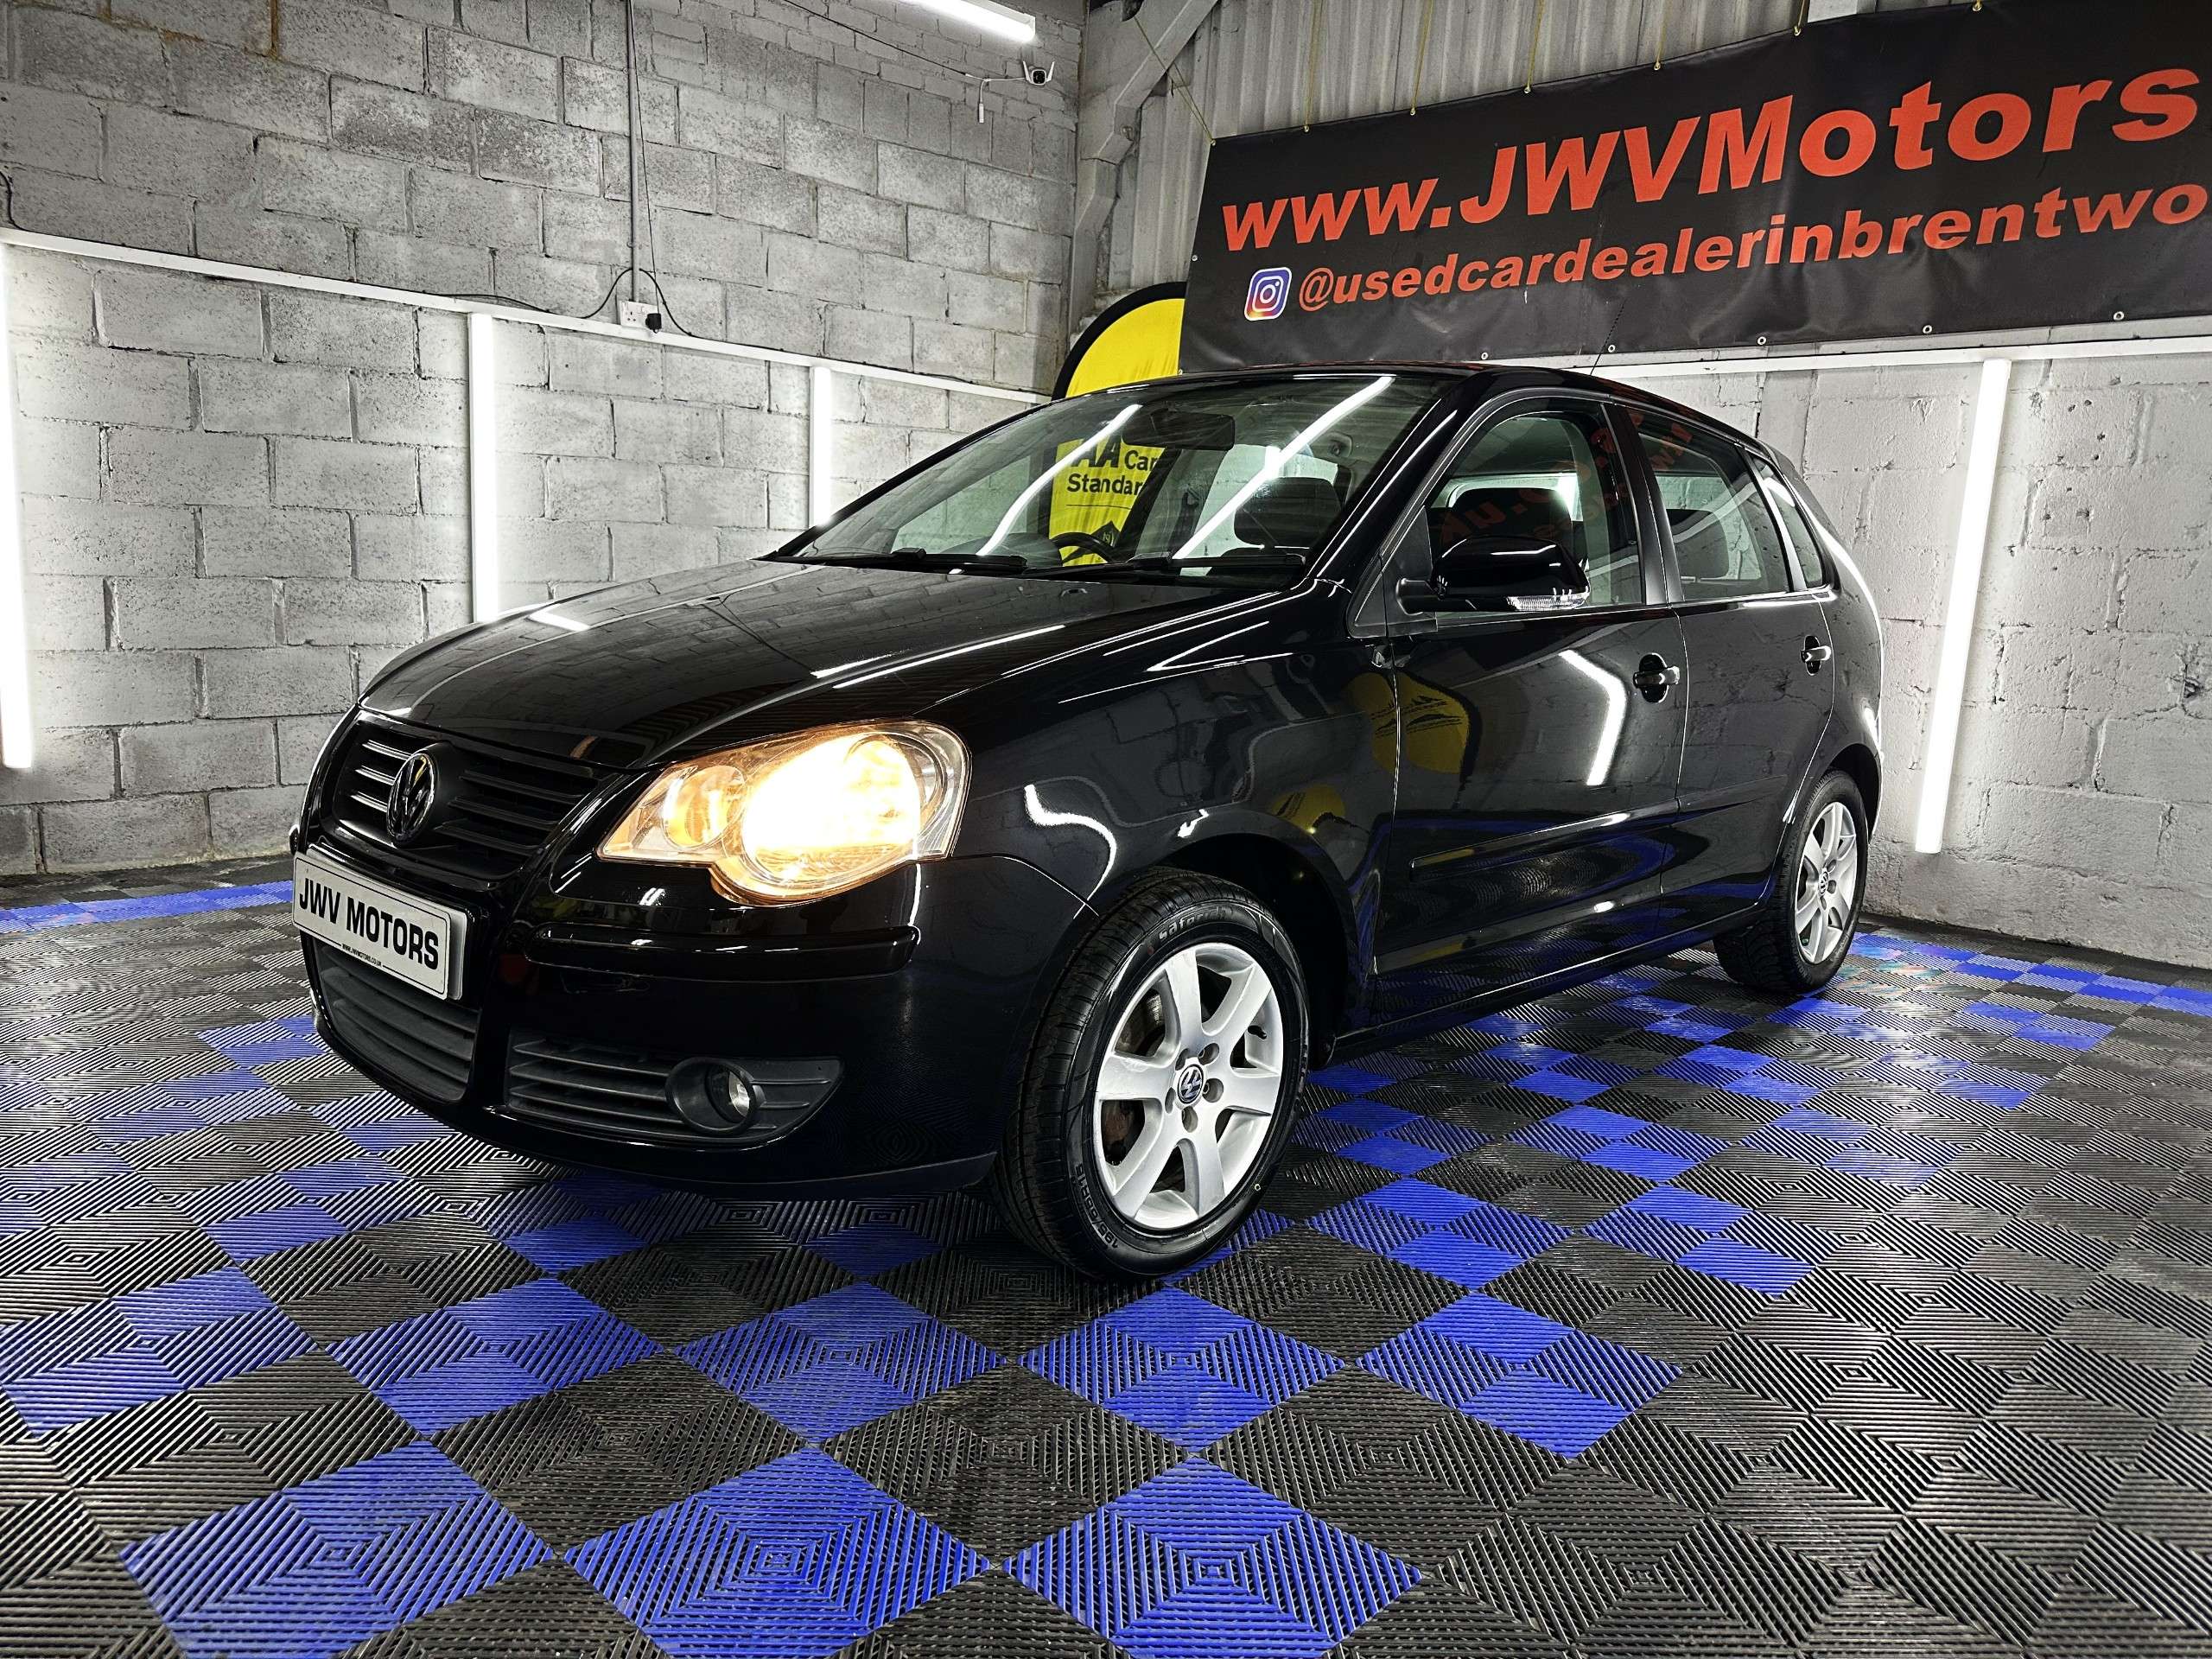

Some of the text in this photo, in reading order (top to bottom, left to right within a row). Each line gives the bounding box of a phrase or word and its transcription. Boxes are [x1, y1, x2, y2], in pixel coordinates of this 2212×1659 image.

[1222, 68, 2200, 251] www.JWVMotors
[1299, 183, 2208, 312] @usedcardealerinbrentwo
[299, 877, 439, 970] JWV MOTORS
